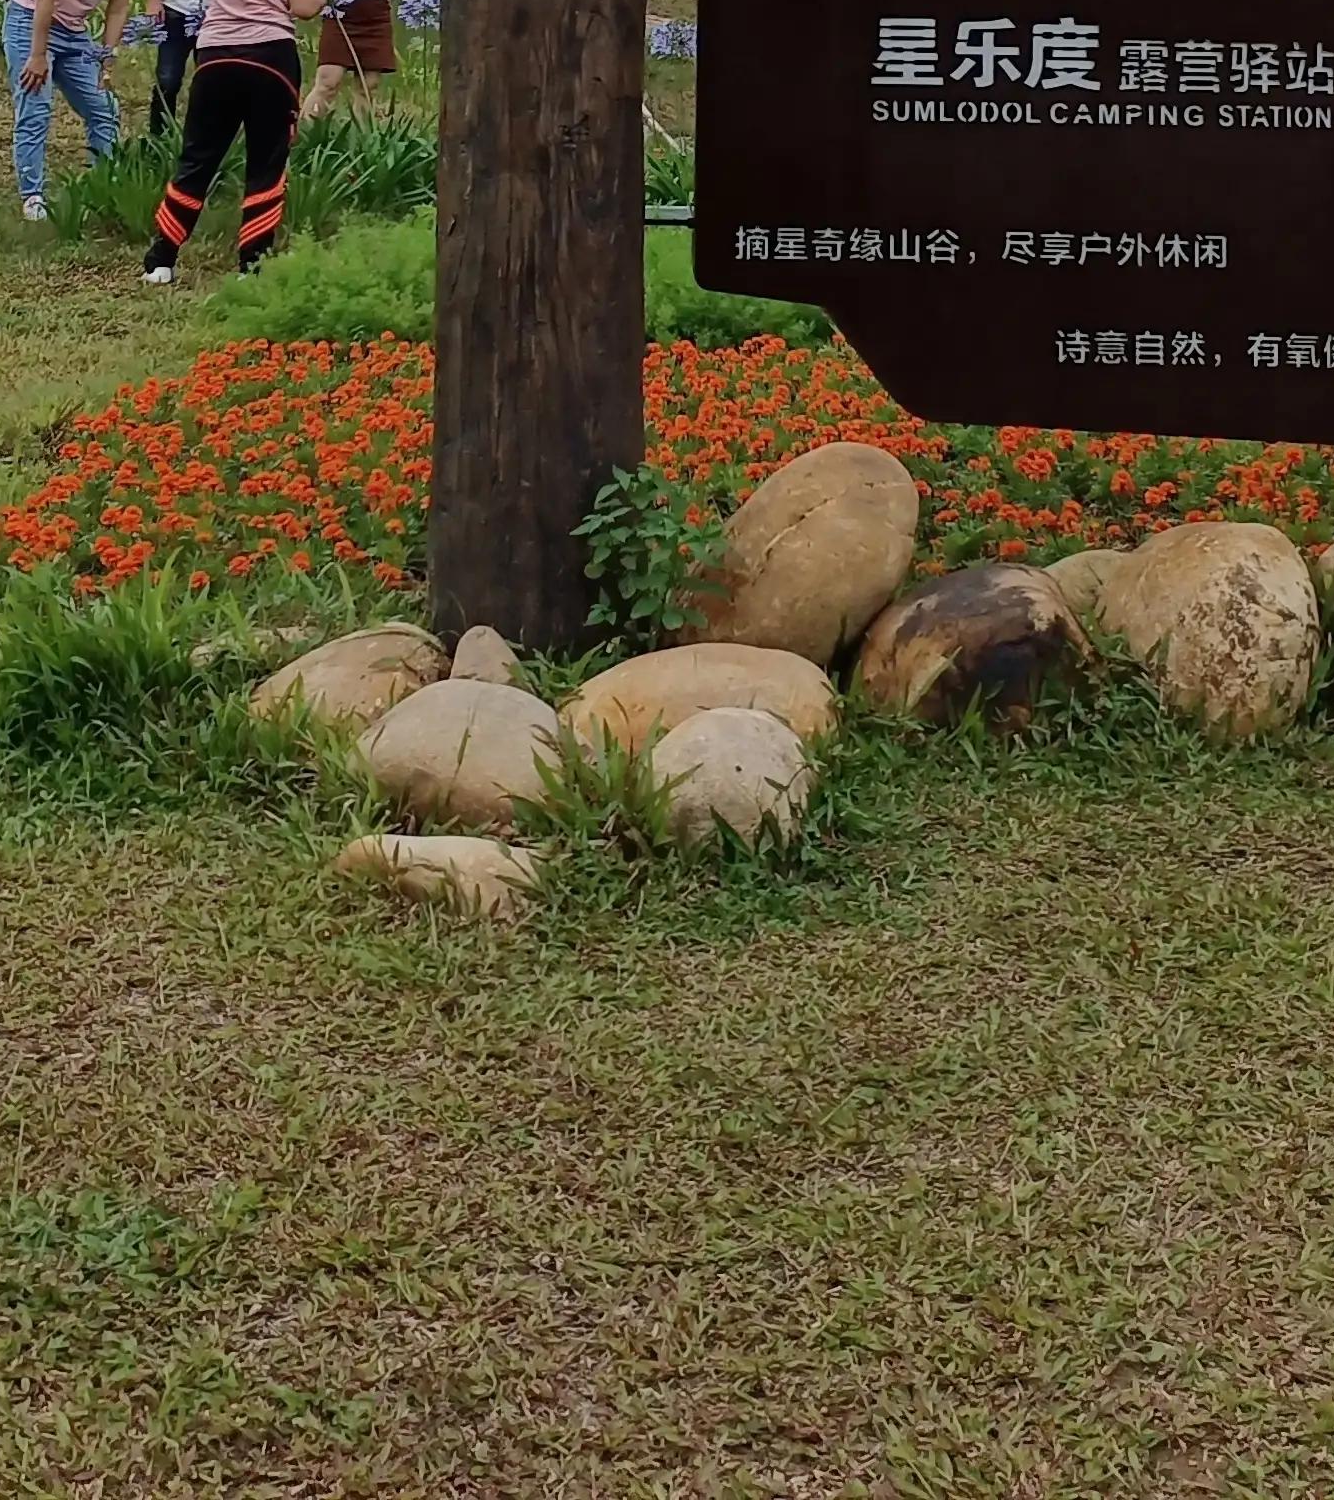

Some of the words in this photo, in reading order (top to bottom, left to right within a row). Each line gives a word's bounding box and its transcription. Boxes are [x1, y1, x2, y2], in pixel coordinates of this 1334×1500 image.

[870, 16, 1101, 91] 星乐度
[872, 99, 1042, 124] SUMLODOL
[1049, 102, 1205, 127] CAMPING
[1217, 104, 1333, 129] STATION
[735, 225, 1228, 268] 摘星奇缘山谷，尽享户外休闲
